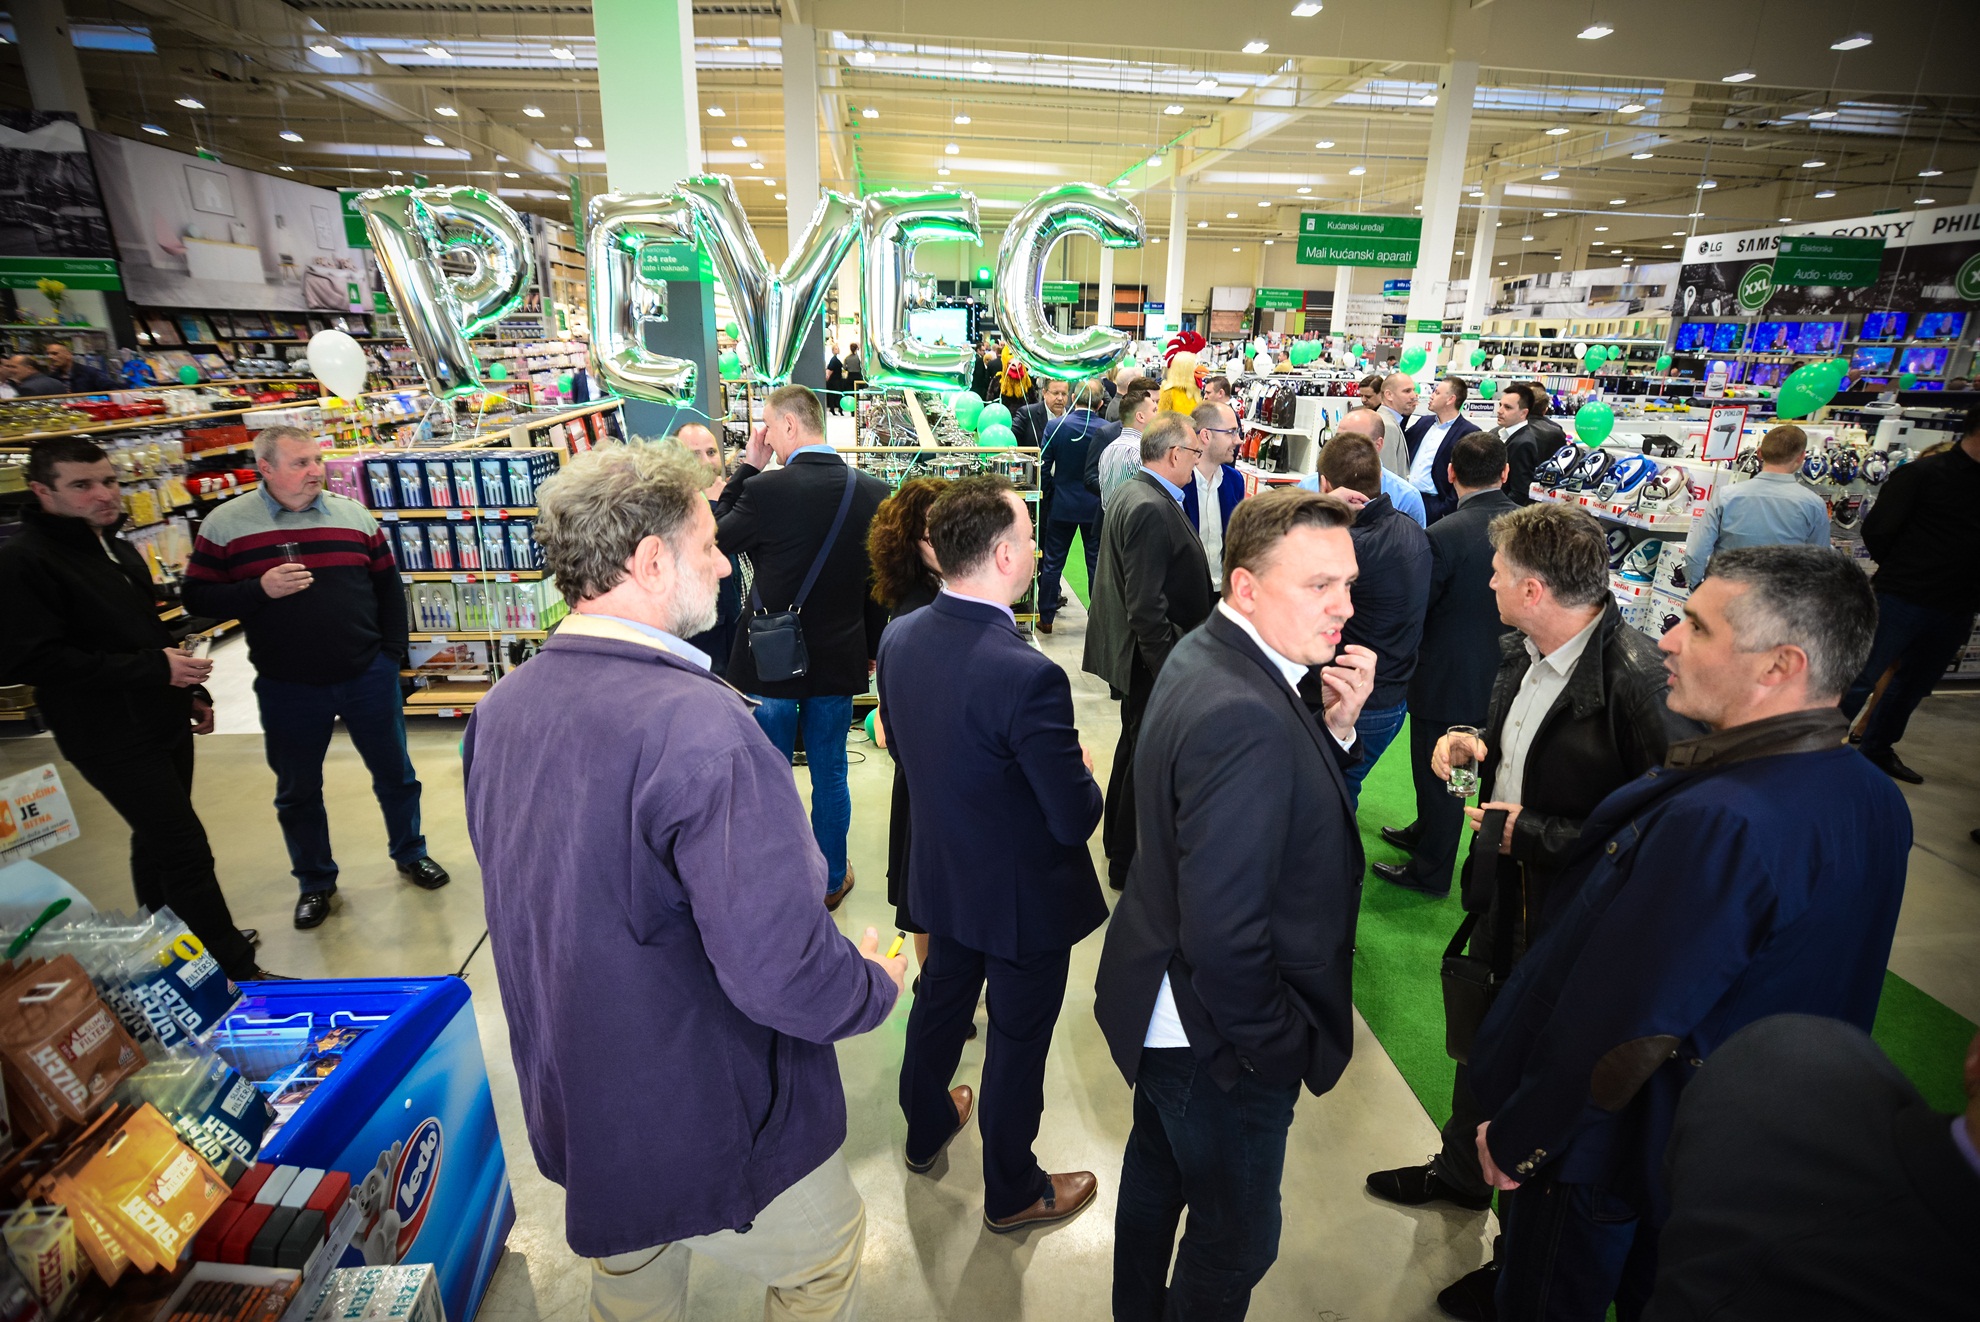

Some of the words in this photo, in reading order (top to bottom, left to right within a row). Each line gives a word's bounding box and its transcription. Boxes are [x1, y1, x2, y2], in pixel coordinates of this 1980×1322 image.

[1327, 221, 1359, 231] Kućanski
[1305, 246, 1327, 259] Mali
[1329, 247, 1374, 261] kućanski
[1376, 250, 1412, 264] aparati
[1710, 241, 1723, 253] LG
[646, 255, 658, 263] 24
[1794, 268, 1820, 281] Audio
[1828, 269, 1854, 281] video
[1744, 278, 1770, 297] XXL
[1532, 486, 1545, 494] Tefal
[1592, 501, 1607, 511] Tefal
[1627, 510, 1644, 520] Tefal
[1613, 581, 1630, 592] Tefal
[20, 803, 40, 821] JE
[185, 960, 213, 985] FILTERS
[149, 977, 203, 1037] GIZEH
[84, 1016, 103, 1033] SLIM
[68, 1026, 88, 1047] XL
[79, 1023, 107, 1049] FILTER
[35, 1045, 89, 1106] GIZEH
[229, 1084, 243, 1100] SLIM
[231, 1087, 251, 1113] FILTER
[201, 1114, 252, 1158] GIZEH
[124, 1195, 180, 1250] GIZEH
